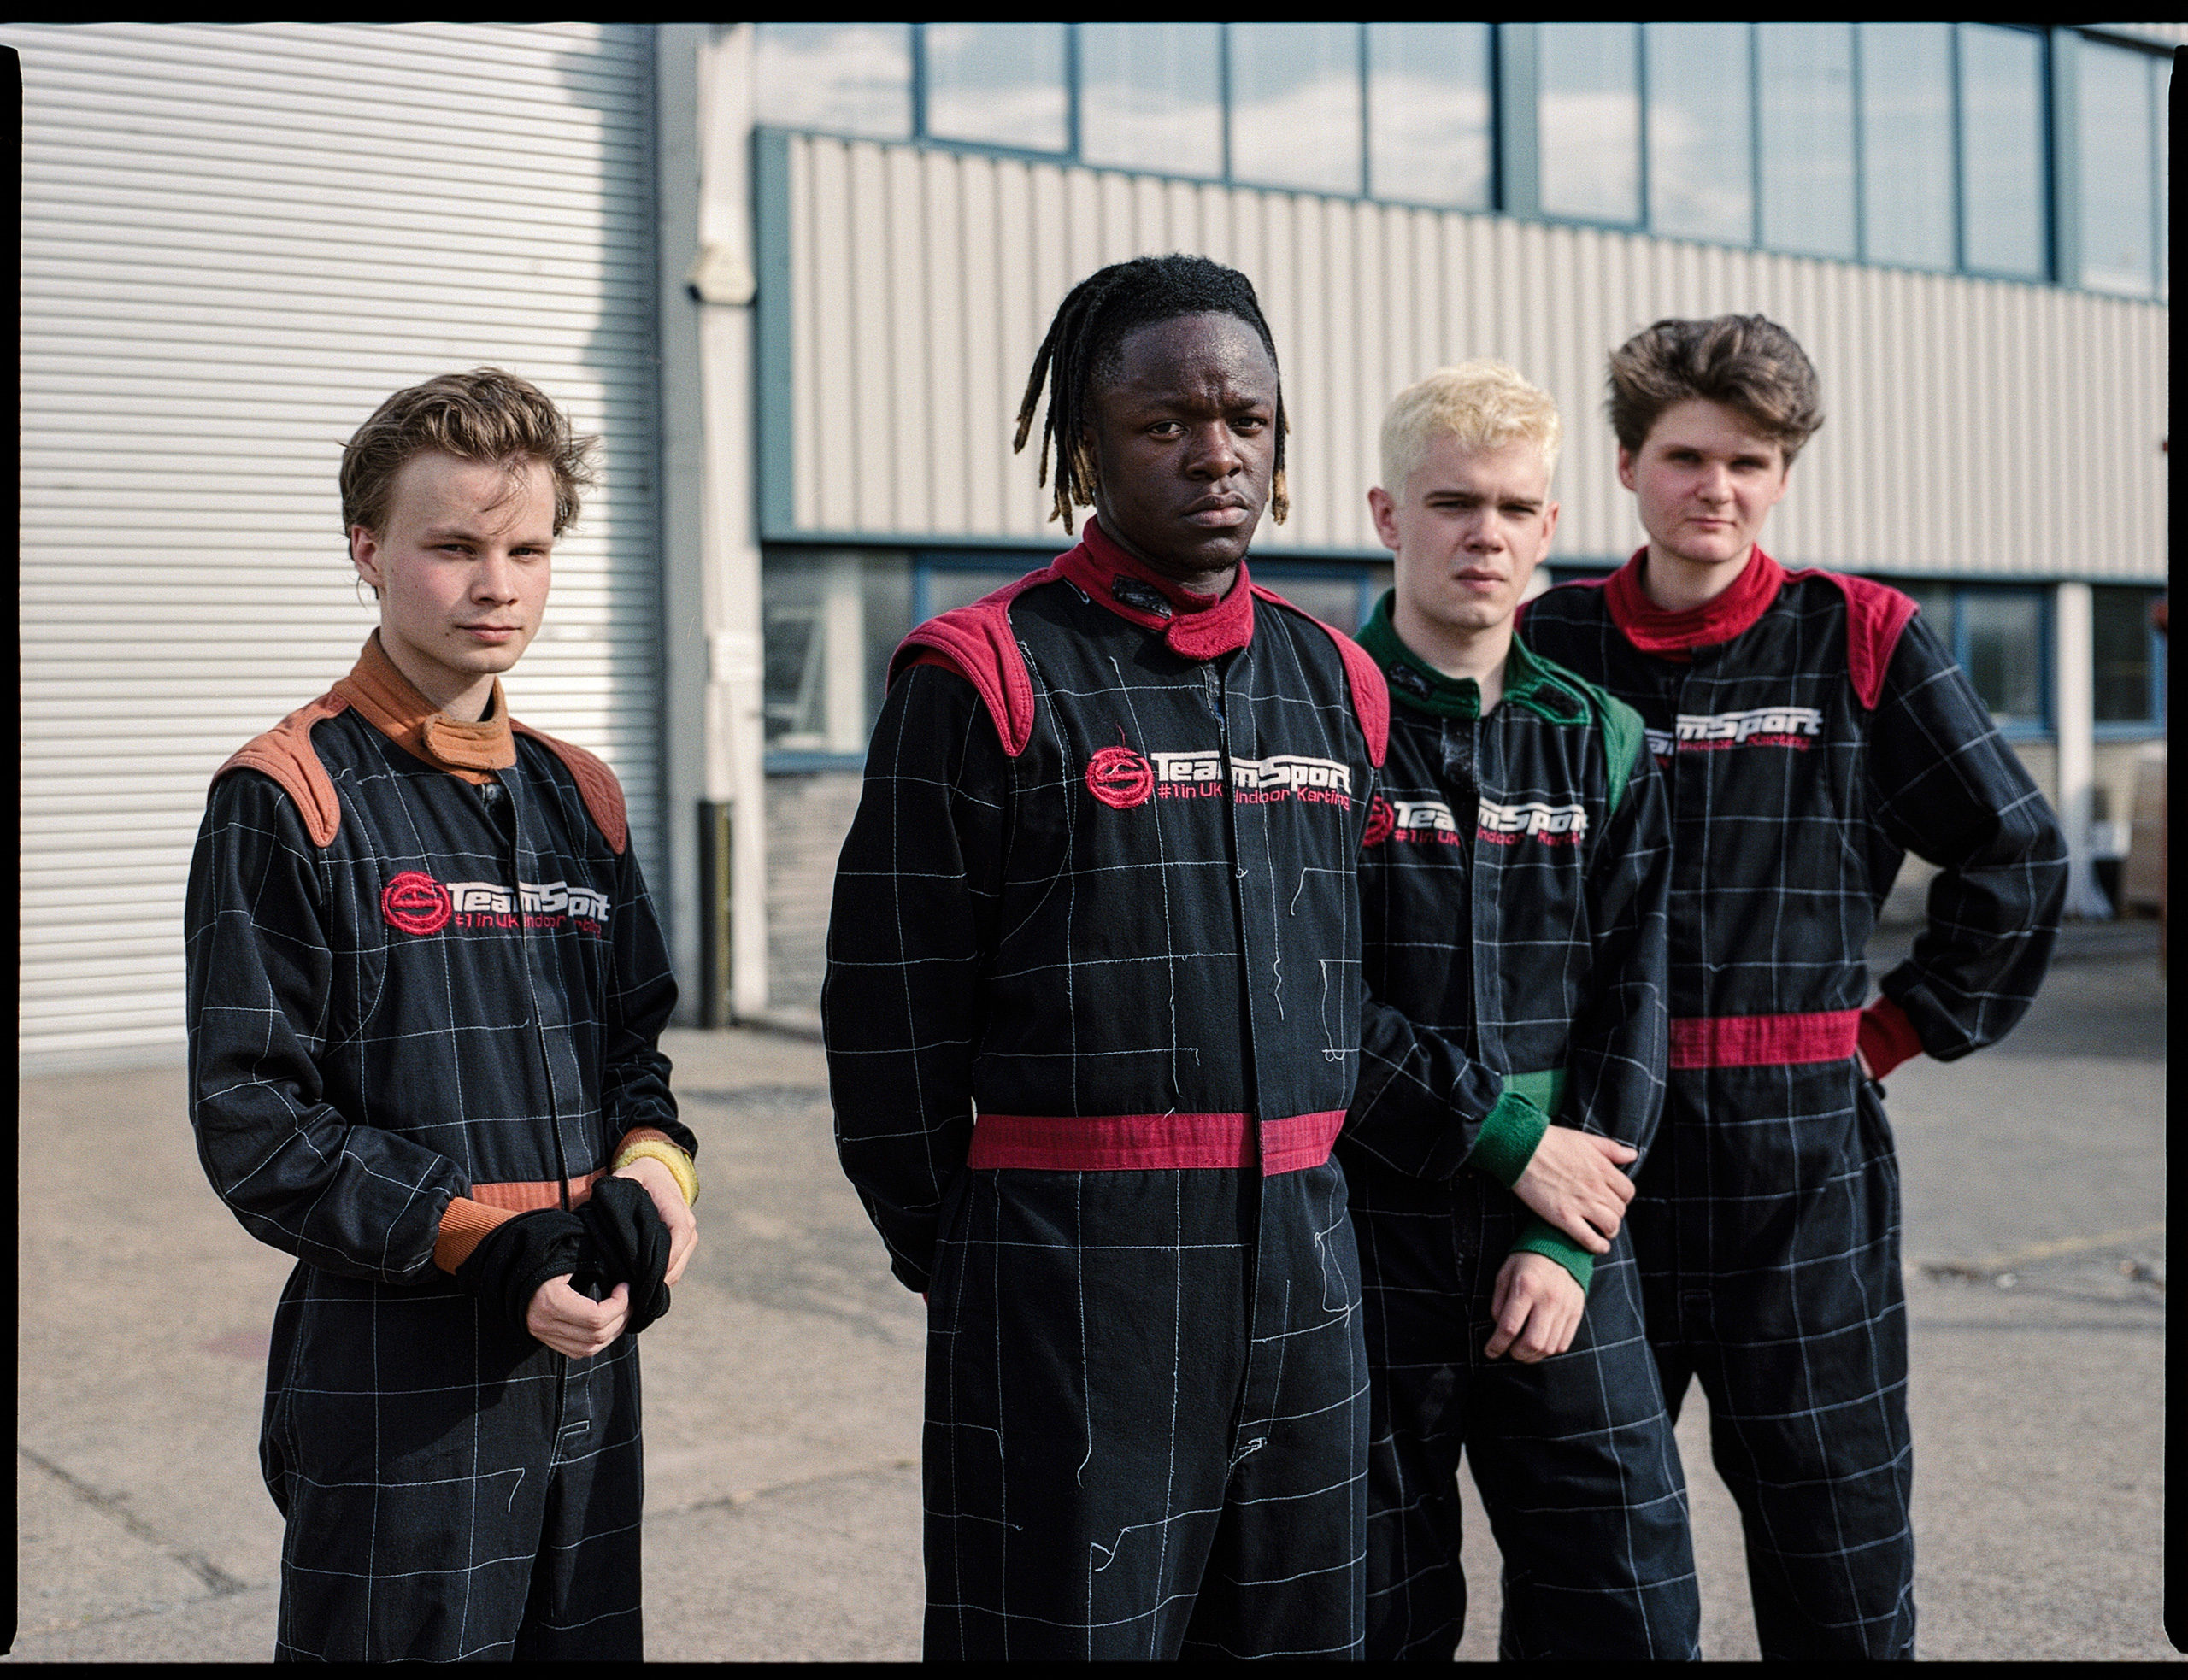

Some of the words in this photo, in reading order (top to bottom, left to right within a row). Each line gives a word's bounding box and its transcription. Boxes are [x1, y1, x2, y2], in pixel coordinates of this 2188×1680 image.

[1150, 750, 1351, 796] TeamSport
[1158, 783, 1179, 800] #1
[1181, 784, 1197, 799] in
[1199, 782, 1224, 797] UK
[1235, 788, 1291, 804] Indoor
[1297, 786, 1350, 812] Karting
[1438, 830, 1461, 848] UK
[446, 881, 611, 921] TeamSport
[475, 913, 493, 928] in
[497, 913, 520, 929] UK
